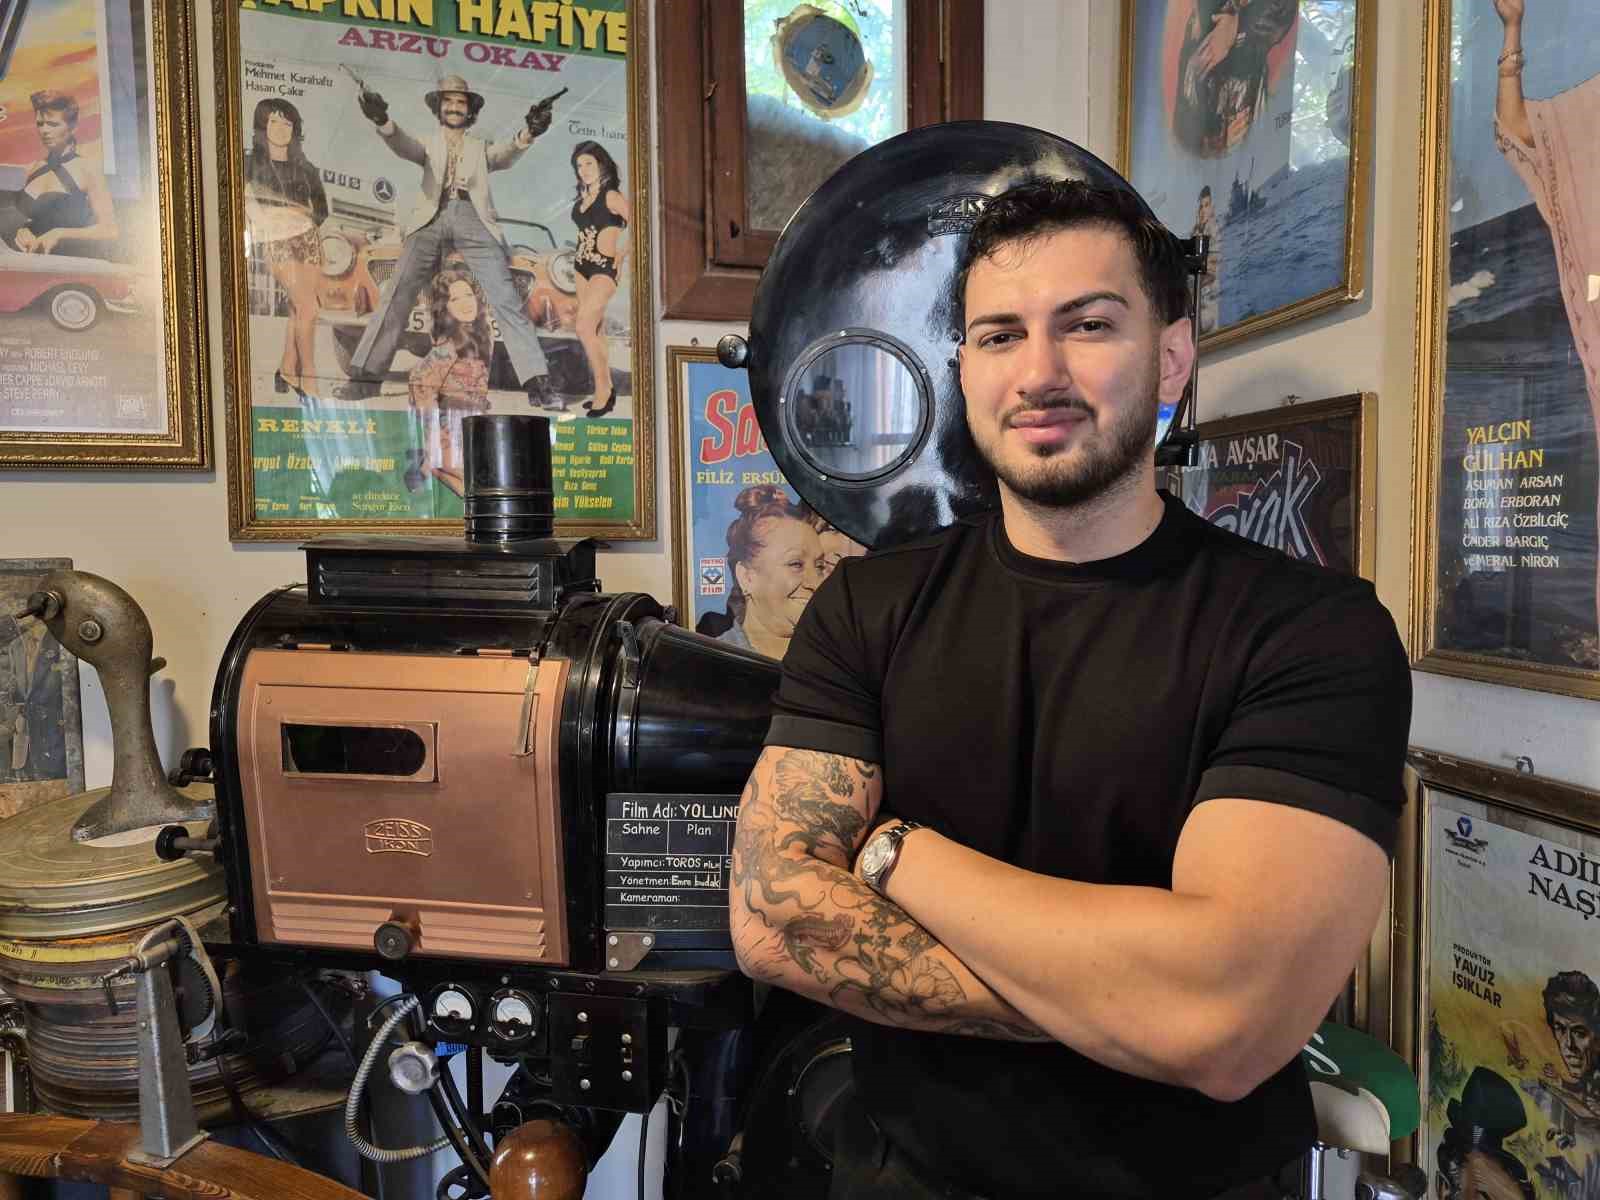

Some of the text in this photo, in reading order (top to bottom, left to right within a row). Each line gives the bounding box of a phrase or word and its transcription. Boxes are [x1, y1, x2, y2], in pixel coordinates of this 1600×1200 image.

[338, 27, 566, 72] ARZU OKAY
[245, 67, 286, 82] Mehmet
[245, 81, 276, 94] Hasan
[699, 389, 770, 464] Sa
[1466, 419, 1531, 446] YALÇIN
[1225, 433, 1280, 470] AVŞAR
[1463, 448, 1544, 473] GÜLHAN
[696, 469, 735, 485] FİLİZ
[1519, 474, 1564, 489] ARSAN
[1463, 494, 1561, 510] BORA ERBORAN
[1483, 516, 1510, 529] RIZA
[1513, 511, 1569, 529] ÖZBİLGİÇ
[1462, 534, 1500, 548] ÖNDER
[1521, 552, 1560, 569] NİRON
[621, 801, 649, 819] Film
[375, 821, 421, 838] ZEISS
[621, 822, 661, 836] Sahne
[686, 823, 712, 837] Plan
[379, 839, 418, 850] IKON
[666, 856, 701, 868] TOROS
[1453, 953, 1496, 987] YAVUZ
